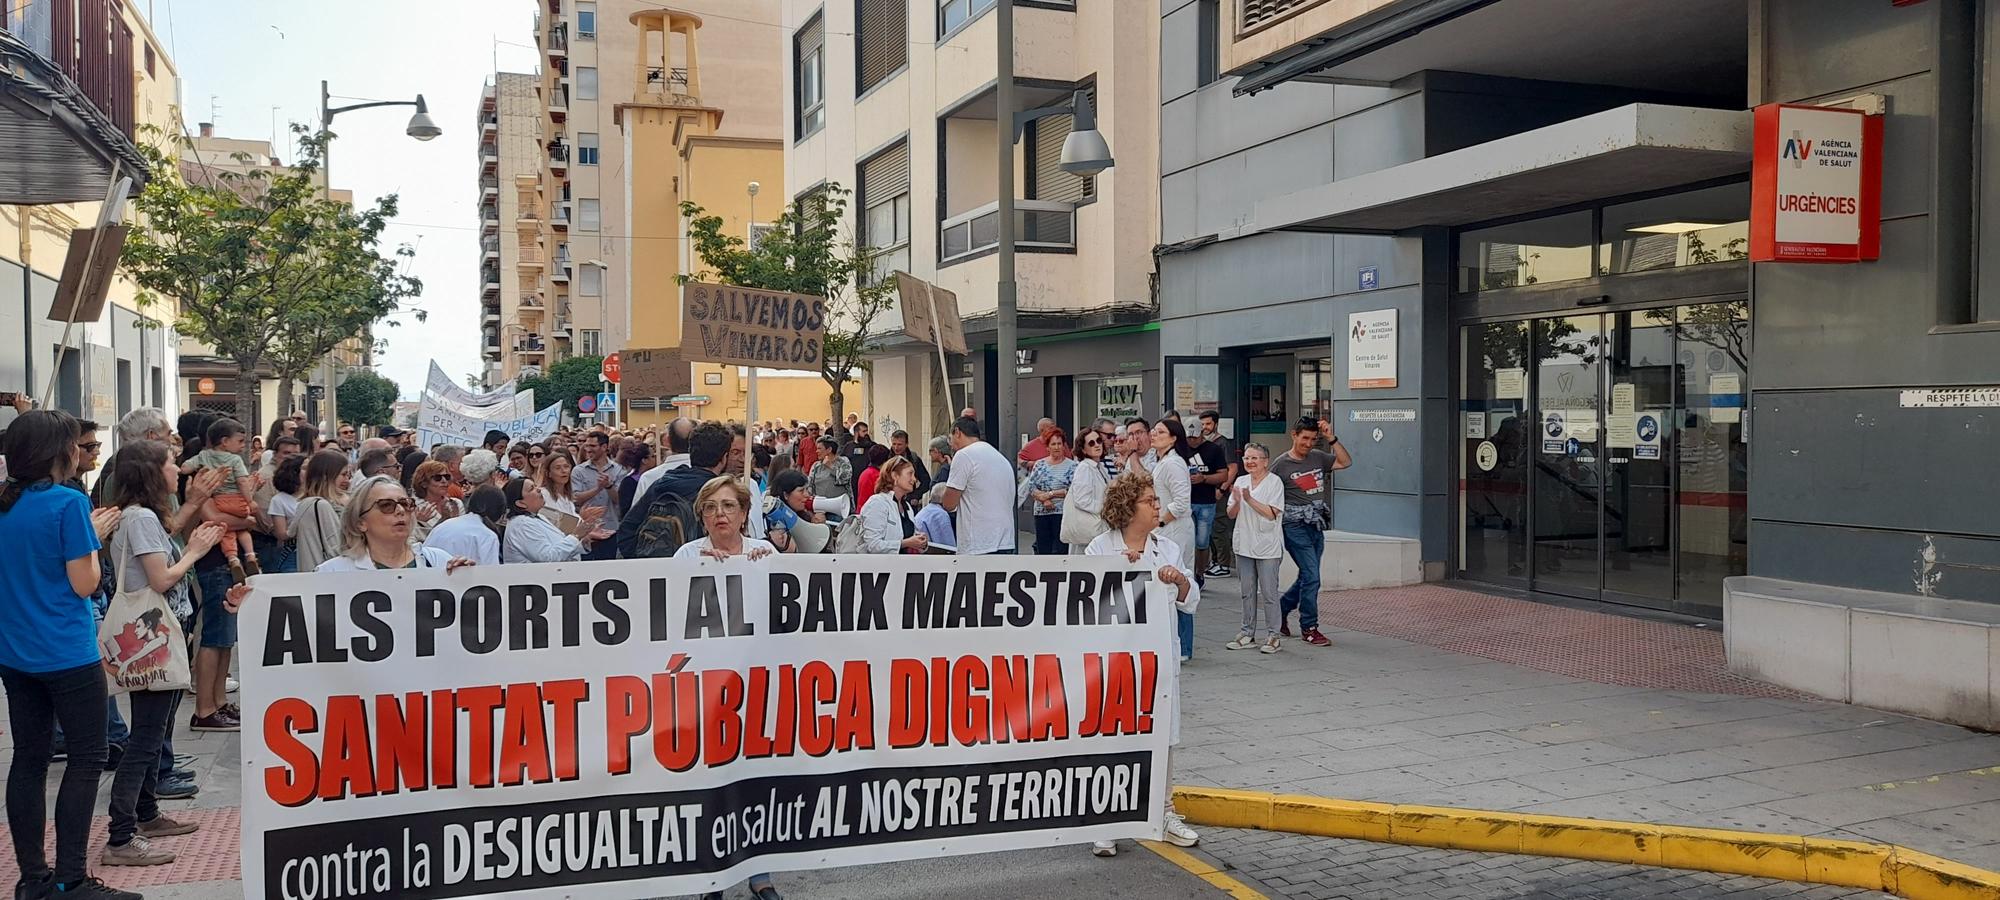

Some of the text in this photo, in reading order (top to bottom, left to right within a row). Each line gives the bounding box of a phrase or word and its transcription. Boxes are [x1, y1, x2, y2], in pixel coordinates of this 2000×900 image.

[1814, 149, 1858, 158] VALENCIANA
[1821, 139, 1852, 148] AGÈNCIA
[1819, 159, 1852, 168] DE SALUT
[1779, 192, 1856, 215] URGÈNCIES
[689, 286, 823, 331] SALVEMOS
[700, 323, 818, 364] VINARÒS
[624, 353, 631, 363] A
[632, 350, 651, 362] TU
[1101, 385, 1137, 405] DKV
[433, 415, 468, 434] PER A
[262, 570, 1153, 667] ALS PORTS I AL BAIX MAESTRAT
[263, 651, 1158, 808] SANITAT PÚBLICA DIGNA JA!
[281, 763, 1141, 900] contra la DESIGUALTAT en salut AL NOSTRE TERRITORI
